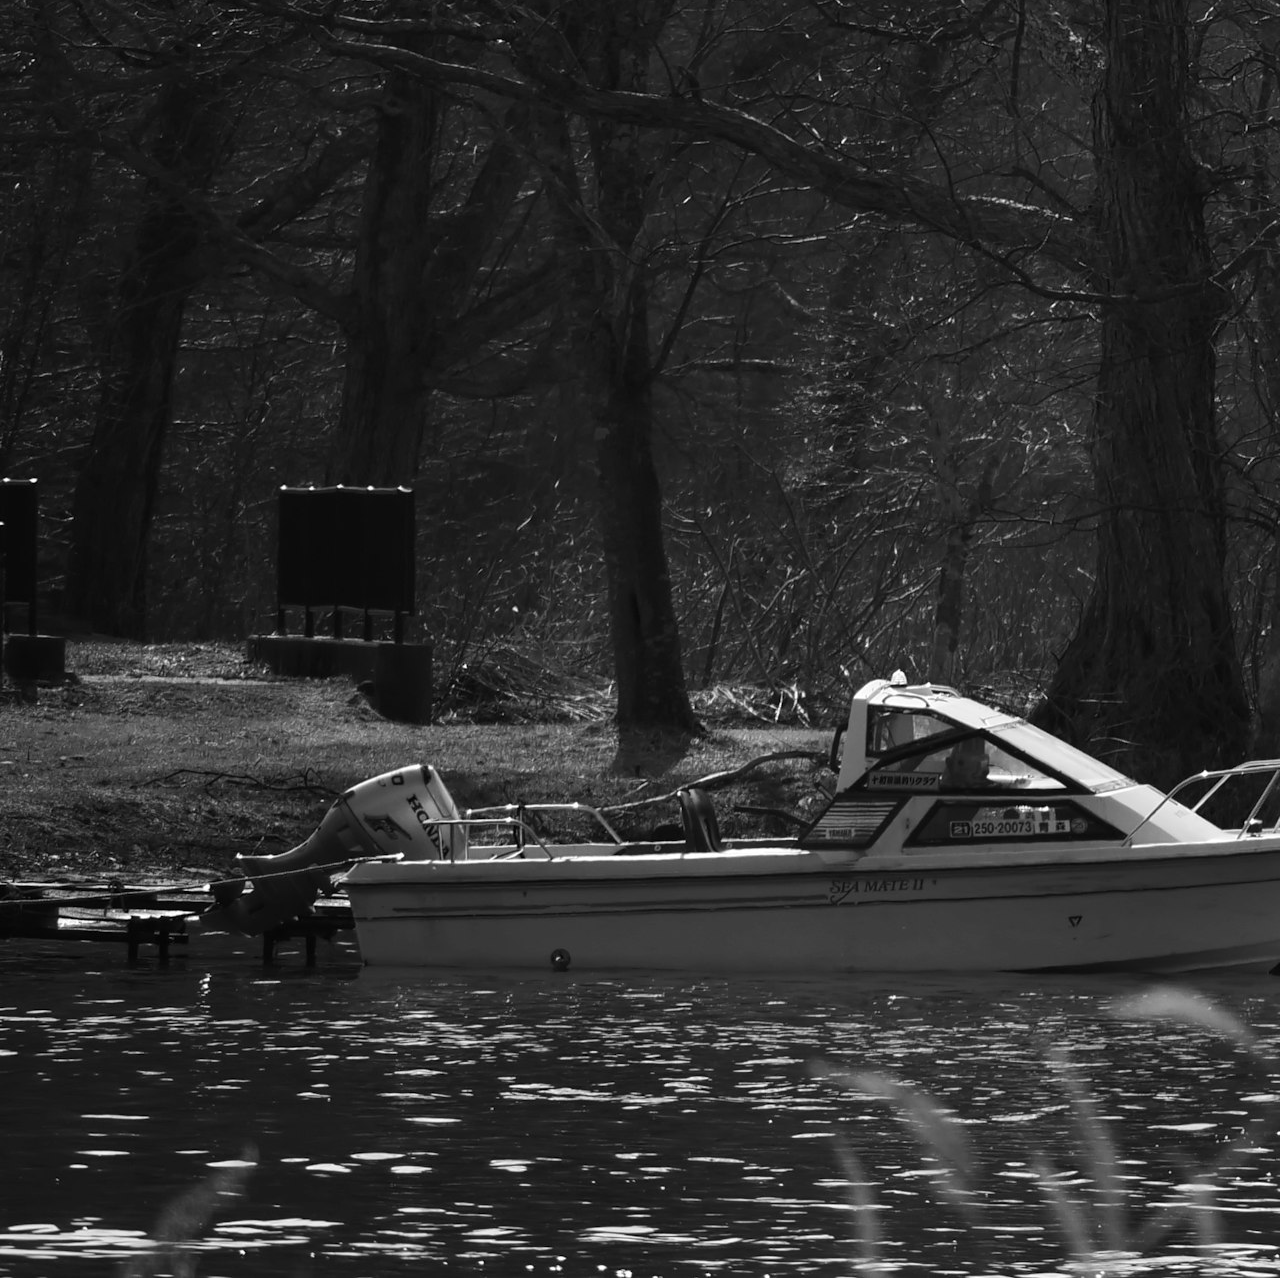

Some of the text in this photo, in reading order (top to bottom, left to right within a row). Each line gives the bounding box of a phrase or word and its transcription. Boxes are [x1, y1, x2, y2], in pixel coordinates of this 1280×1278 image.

[406, 793, 450, 860] HONDA
[830, 879, 860, 903] SEA
[864, 879, 909, 892] MATE
